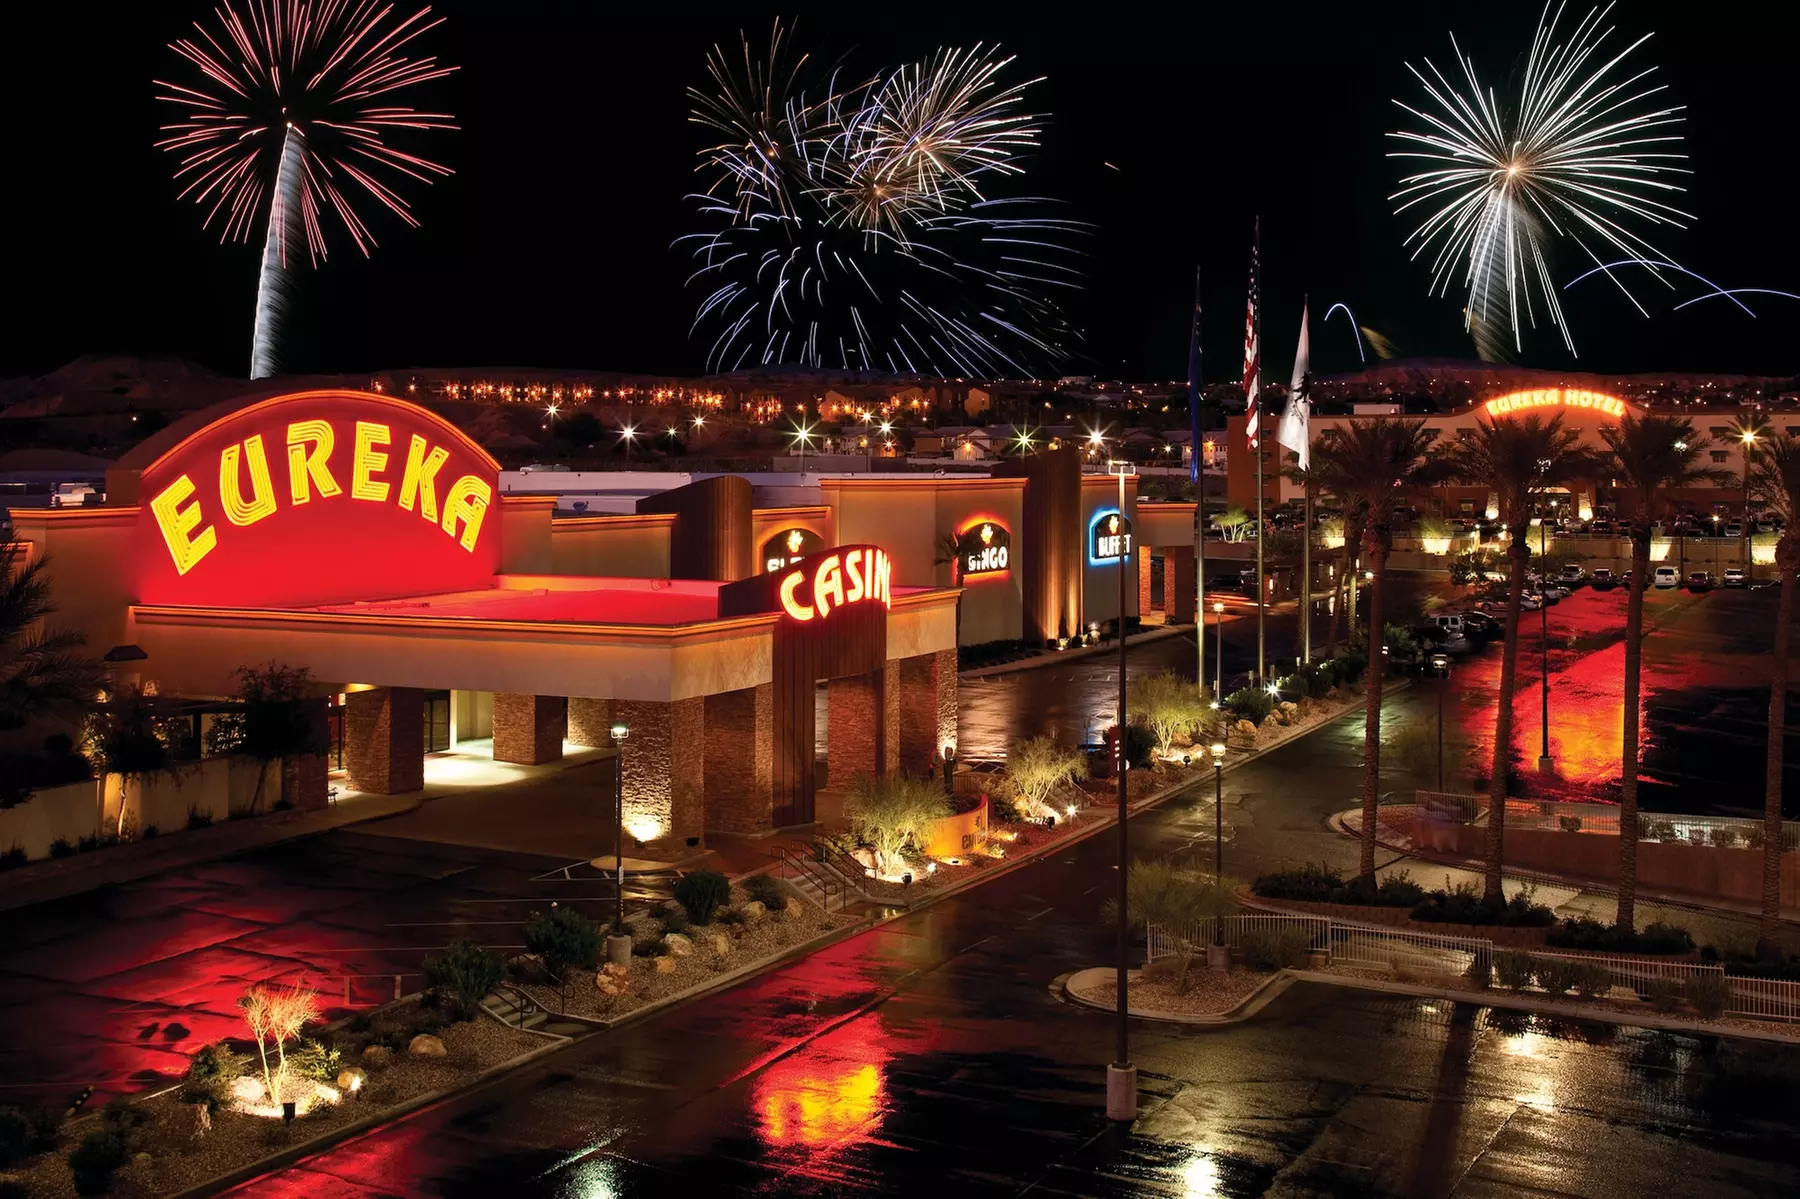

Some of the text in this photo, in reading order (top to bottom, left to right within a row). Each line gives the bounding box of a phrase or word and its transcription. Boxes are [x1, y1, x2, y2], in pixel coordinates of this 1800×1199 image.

[1486, 389, 1625, 417] EUREKA HOTEL
[150, 420, 492, 576] EUREKA
[1098, 534, 1131, 556] BUFFT
[780, 549, 891, 621] CASIN
